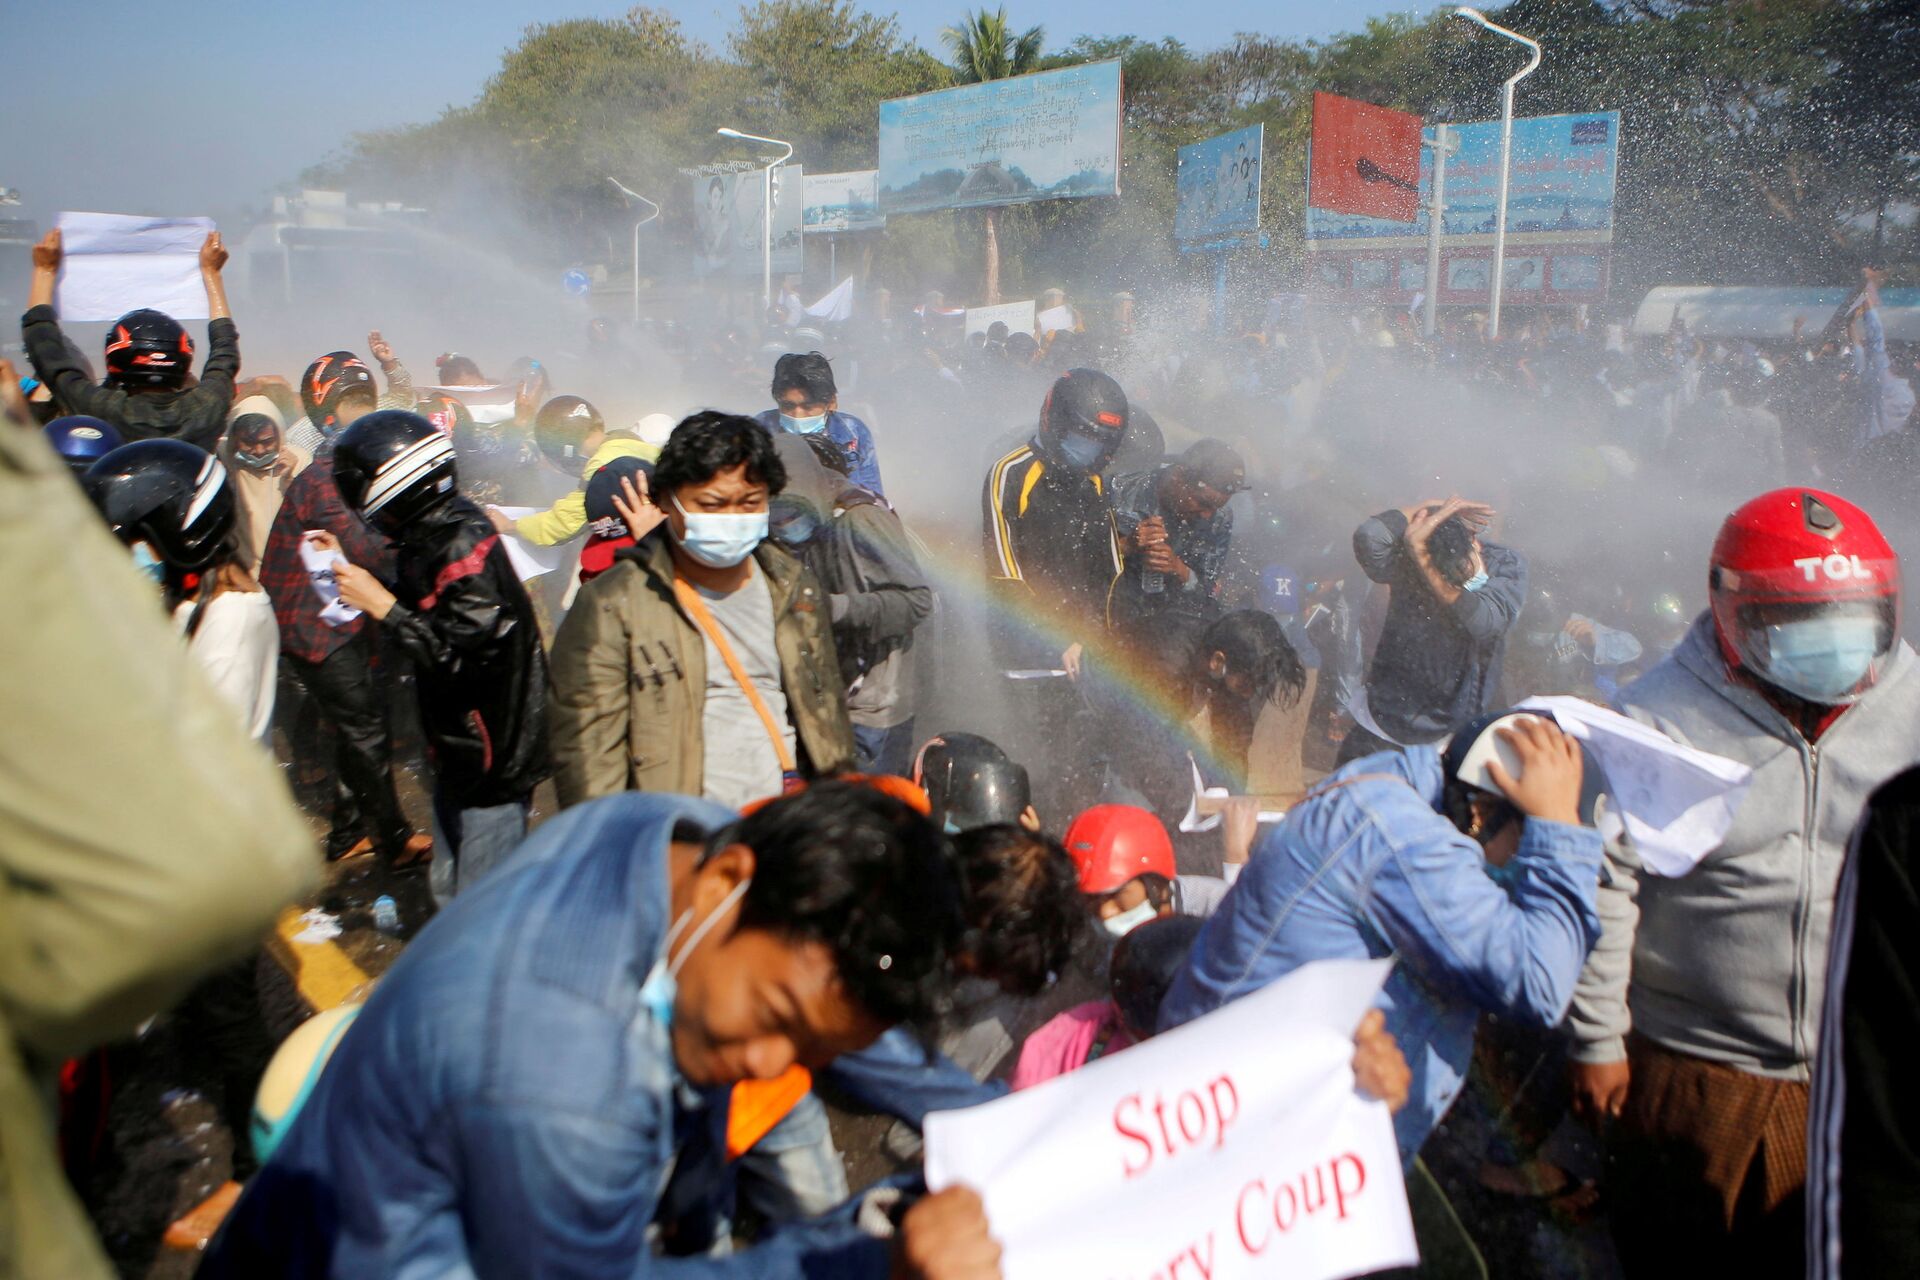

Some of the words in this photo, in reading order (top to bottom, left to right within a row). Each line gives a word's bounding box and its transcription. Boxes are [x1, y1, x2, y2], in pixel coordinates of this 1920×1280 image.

[1794, 553, 1872, 586] TOL
[1111, 1072, 1240, 1180] Stop
[1234, 1150, 1367, 1257] Coup
